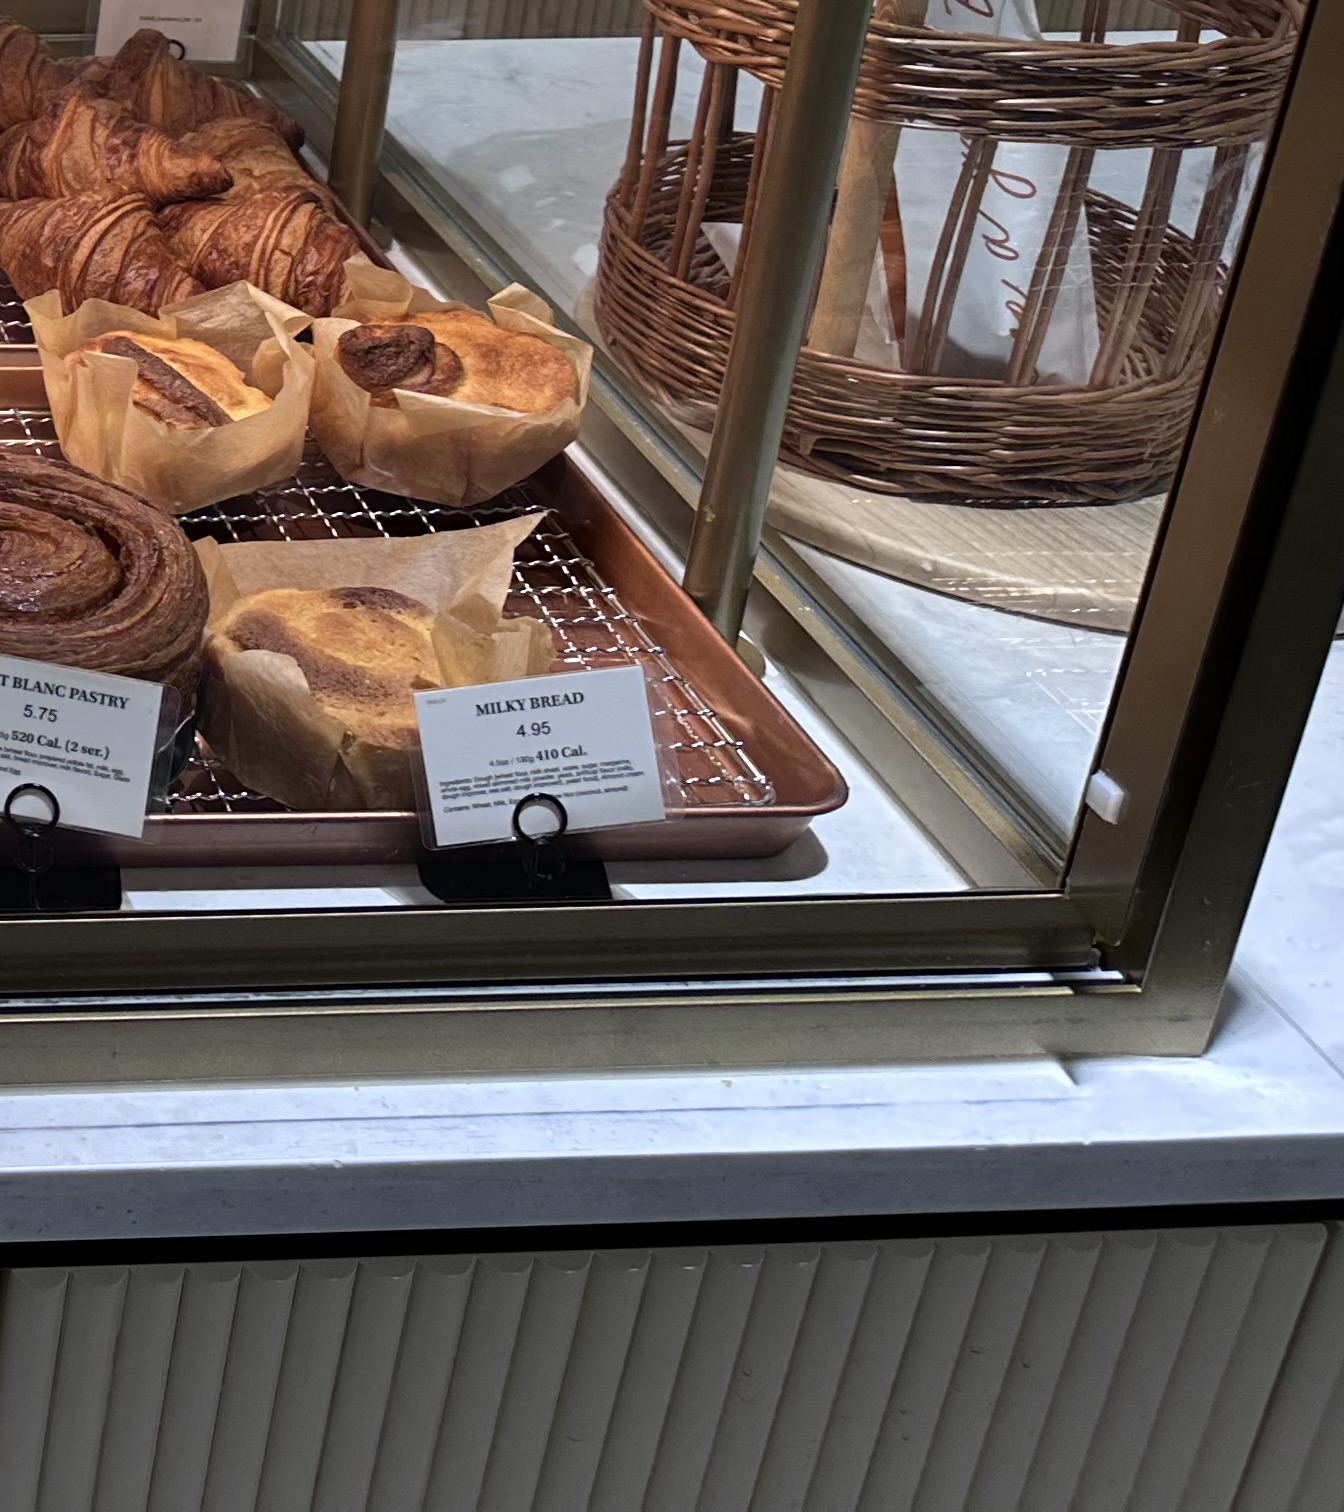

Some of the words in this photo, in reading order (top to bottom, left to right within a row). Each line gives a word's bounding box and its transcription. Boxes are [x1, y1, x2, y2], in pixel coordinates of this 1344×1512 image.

[12, 676, 67, 698] BLANC
[69, 687, 131, 710] PASTRY
[475, 699, 527, 717] MILKY
[530, 691, 585, 710] BREAD
[23, 704, 58, 723] 5.75
[516, 721, 552, 738] 4.95
[11, 730, 34, 744] 520
[37, 734, 62, 749] Cal.
[65, 738, 78, 753] (2
[81, 744, 110, 760] ser.)
[536, 749, 559, 761] 410
[561, 745, 588, 758] Cal.
